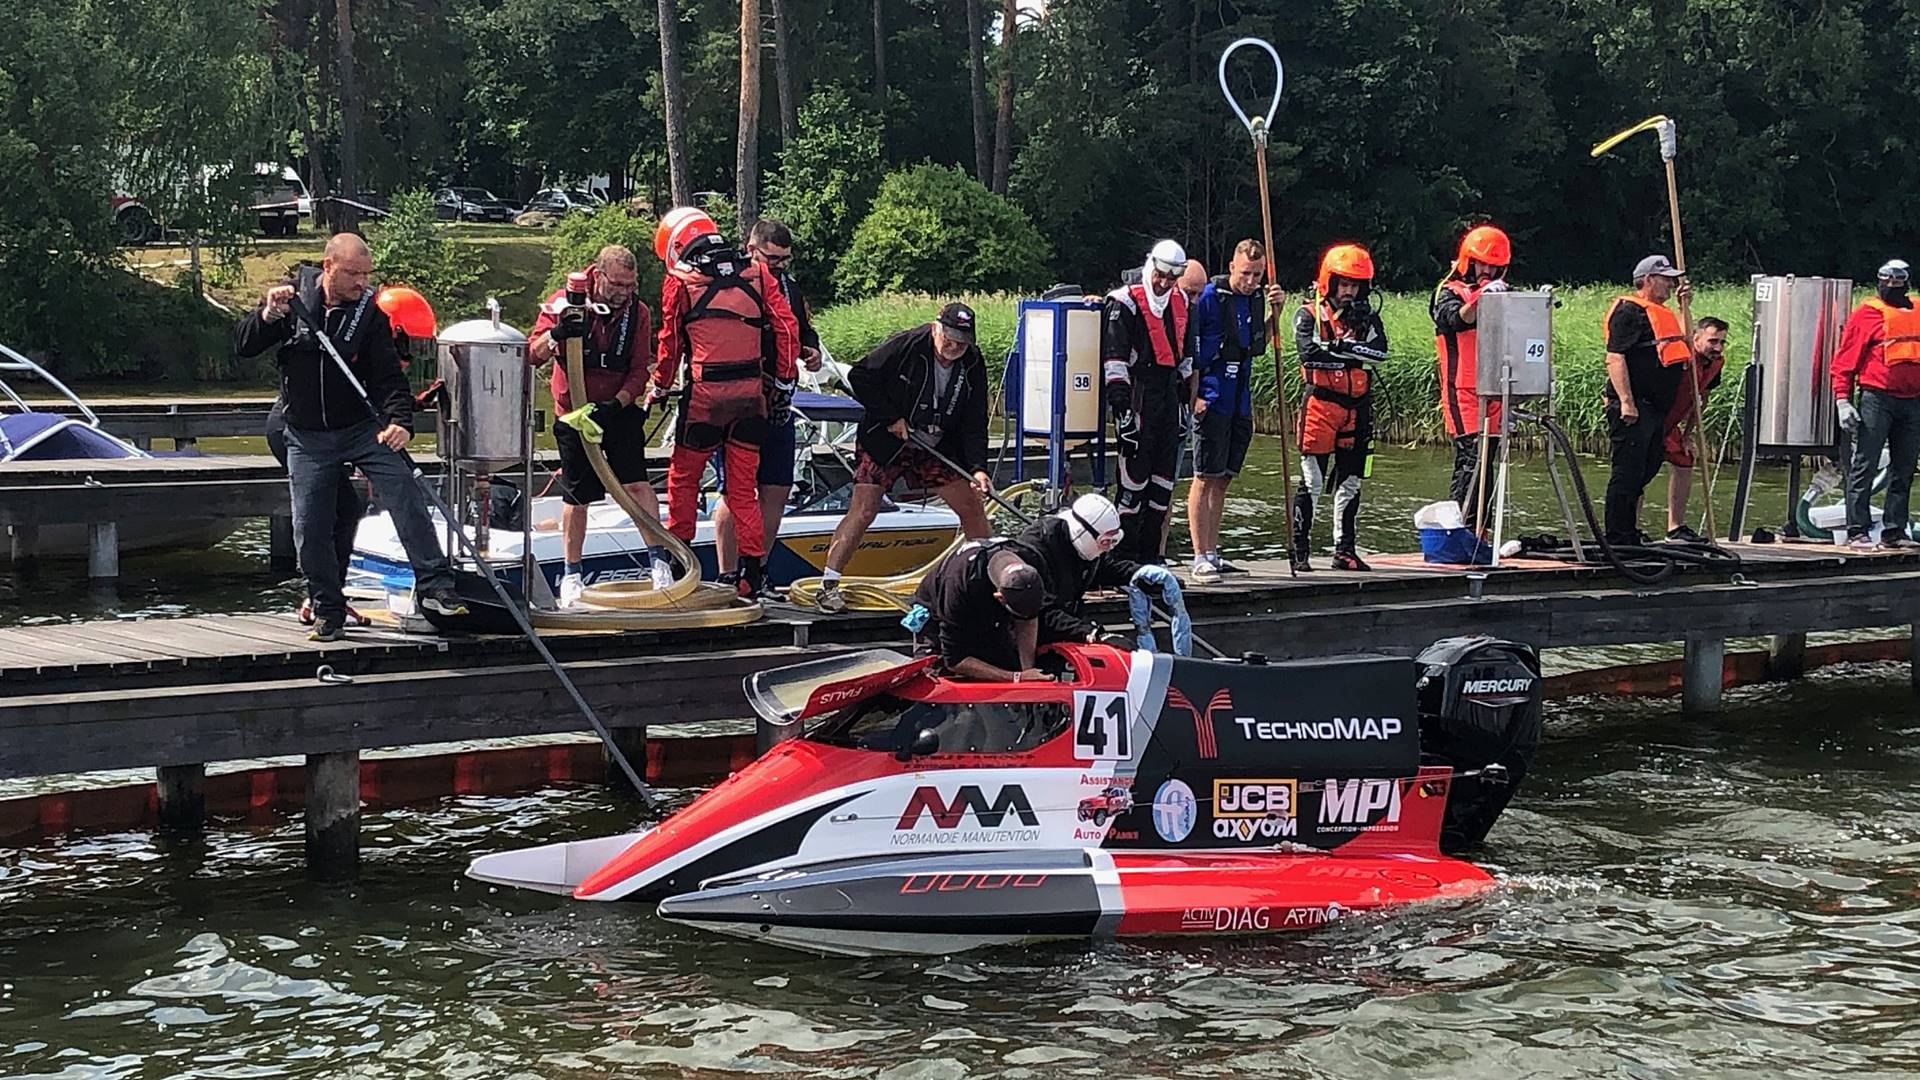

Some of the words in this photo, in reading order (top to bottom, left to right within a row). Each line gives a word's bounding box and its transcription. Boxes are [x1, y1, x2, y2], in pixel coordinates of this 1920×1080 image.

[1527, 343, 1545, 358] 49
[482, 365, 504, 397] 41
[1074, 376, 1090, 388] 38
[1462, 678, 1532, 694] MERCURY
[1076, 695, 1128, 756] 41
[1220, 785, 1290, 811] JCB
[1318, 779, 1401, 824] MPI
[890, 832, 959, 845] NORMANDIE
[961, 830, 1040, 843] MANUTENTION
[1073, 827, 1102, 840] AUTO
